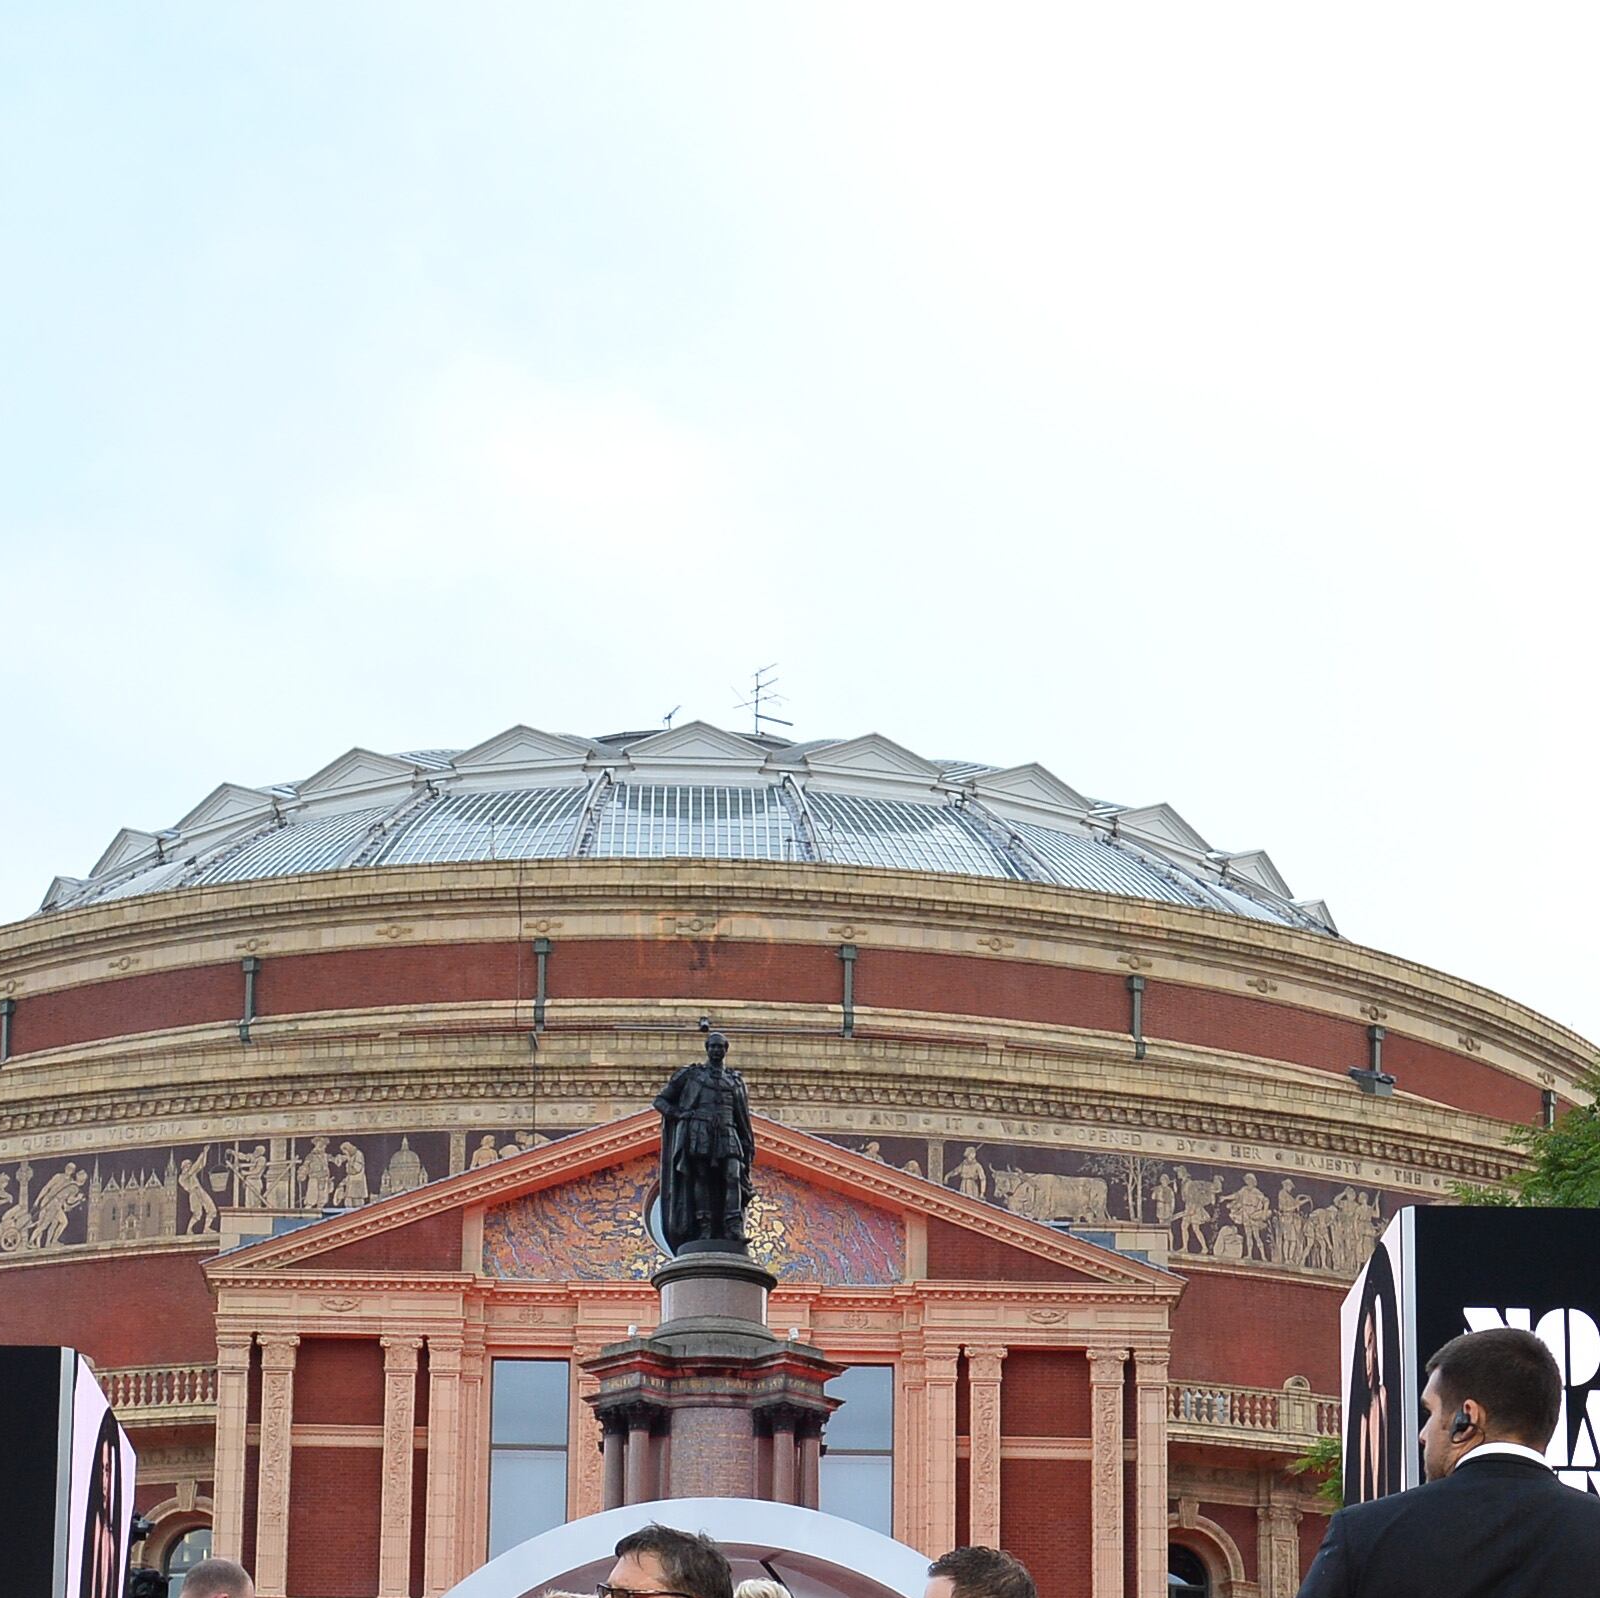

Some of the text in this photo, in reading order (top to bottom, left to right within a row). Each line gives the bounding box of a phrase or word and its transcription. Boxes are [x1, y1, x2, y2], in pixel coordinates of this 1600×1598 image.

[22, 1132, 73, 1150] QUEEN
[108, 1124, 185, 1141] VICTORIA
[869, 1113, 908, 1127] AND
[945, 1117, 963, 1130] IT
[1000, 1121, 1040, 1137] WAS
[1076, 1127, 1143, 1146] OPENED
[1176, 1138, 1197, 1152] BY
[1230, 1144, 1262, 1161] HER
[1294, 1153, 1363, 1176] MAJESTY
